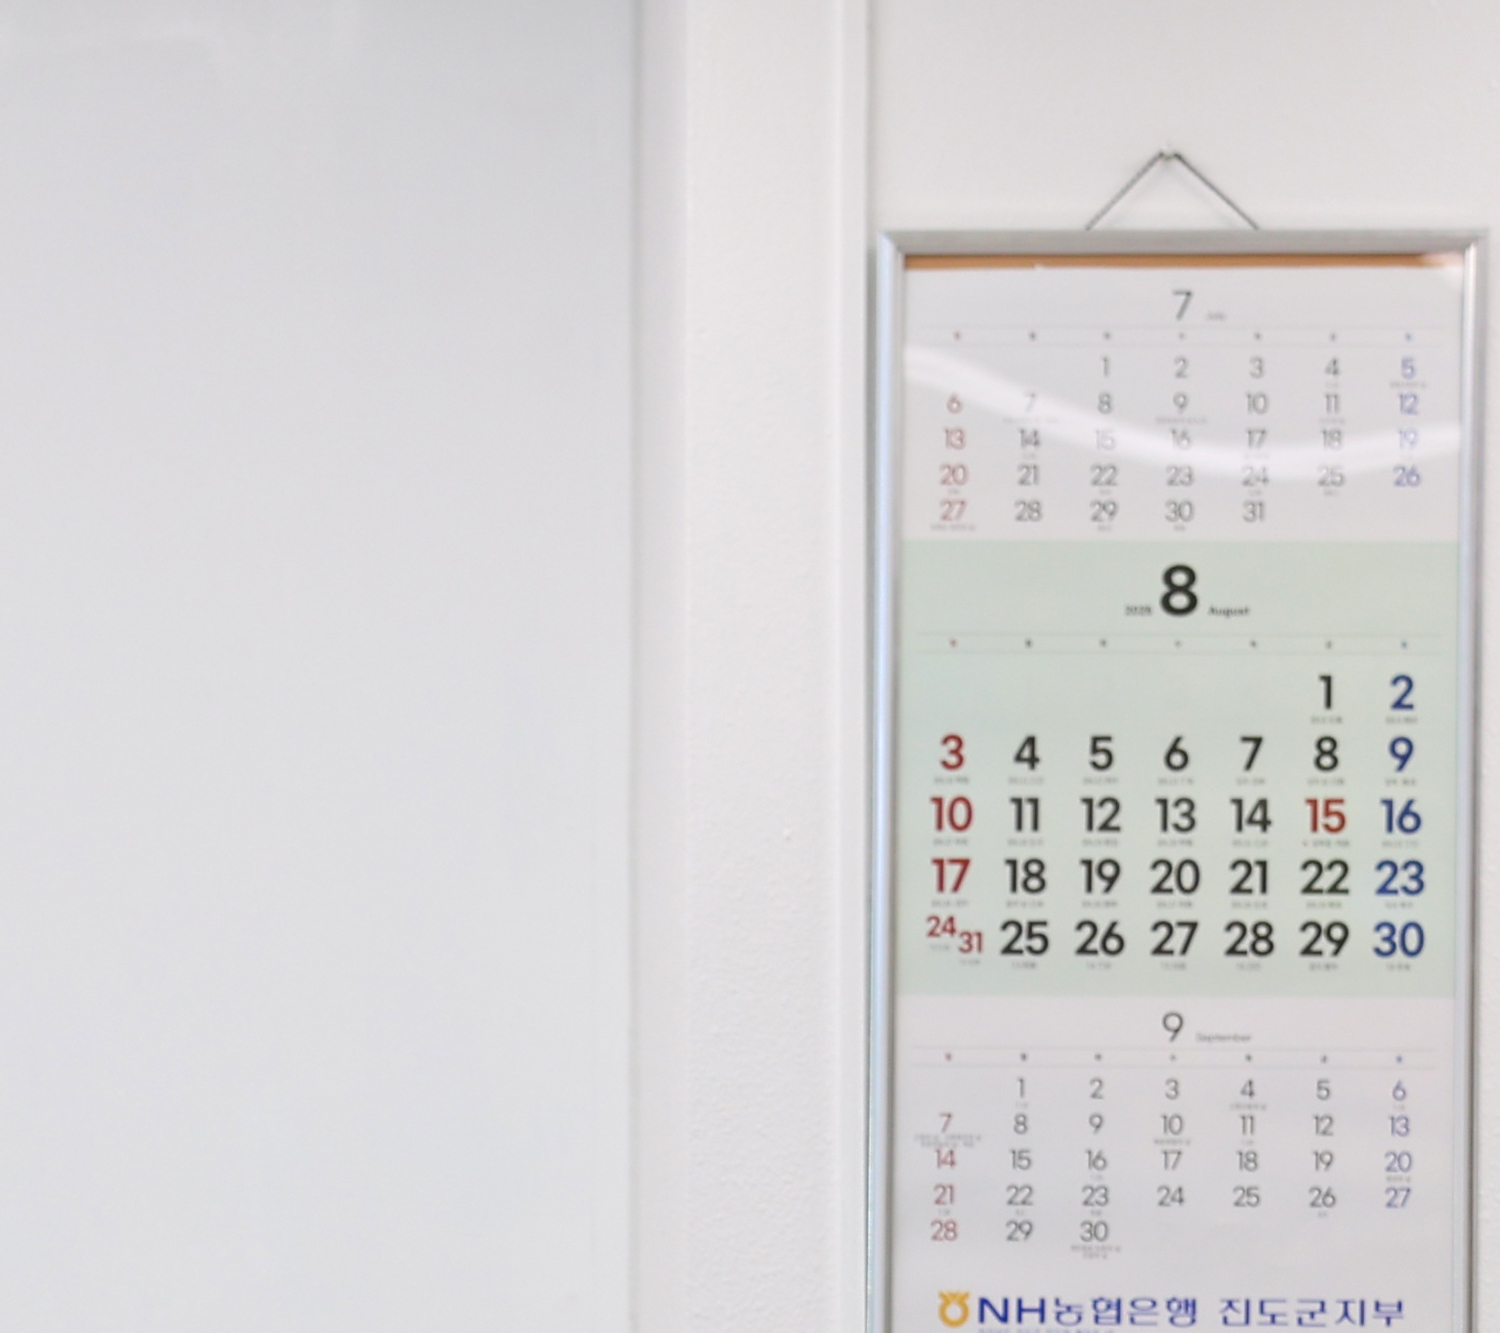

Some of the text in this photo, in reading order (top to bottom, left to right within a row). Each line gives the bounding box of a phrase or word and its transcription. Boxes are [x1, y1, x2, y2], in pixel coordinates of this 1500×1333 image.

[1173, 290, 1193, 320] 7
[1101, 356, 1416, 380] 1 2 3 4 5
[946, 394, 963, 414] 6
[1098, 392, 1113, 414] 8
[1173, 392, 1189, 414] 9
[1246, 392, 1269, 415] 10
[1325, 392, 1340, 414] 11
[1398, 393, 1419, 415] 12
[944, 426, 1418, 452] 13 14 15 16 17 18 19
[940, 463, 1422, 489] 20 21 22 23 24 25 26
[940, 499, 1265, 522] 27 28 29 30 31
[1160, 564, 1198, 617] 8
[1208, 605, 1250, 618] August
[1319, 674, 1414, 710] 1 2
[940, 734, 1414, 772] 3 4 5 6 7 8 9
[930, 796, 1422, 834] 10 11 12 13 14 15 16
[932, 858, 1425, 896] 17 18 19 20 21 22 23
[928, 916, 1425, 958] 24 31 25 26 27 28 29 30
[1162, 1012, 1184, 1042] 9
[1018, 1077, 1407, 1102] 1 2 3 4 5 6
[940, 1113, 1410, 1137] 7 8 9 10 11 12 13
[935, 1146, 1413, 1173] 14 15 16 17 18 19 20
[934, 1183, 1411, 1208] 21 22 23 24 25 26 27
[931, 1219, 1109, 1242] 28 29 30
[977, 1296, 1405, 1328] NH농협은행 진도군지부
